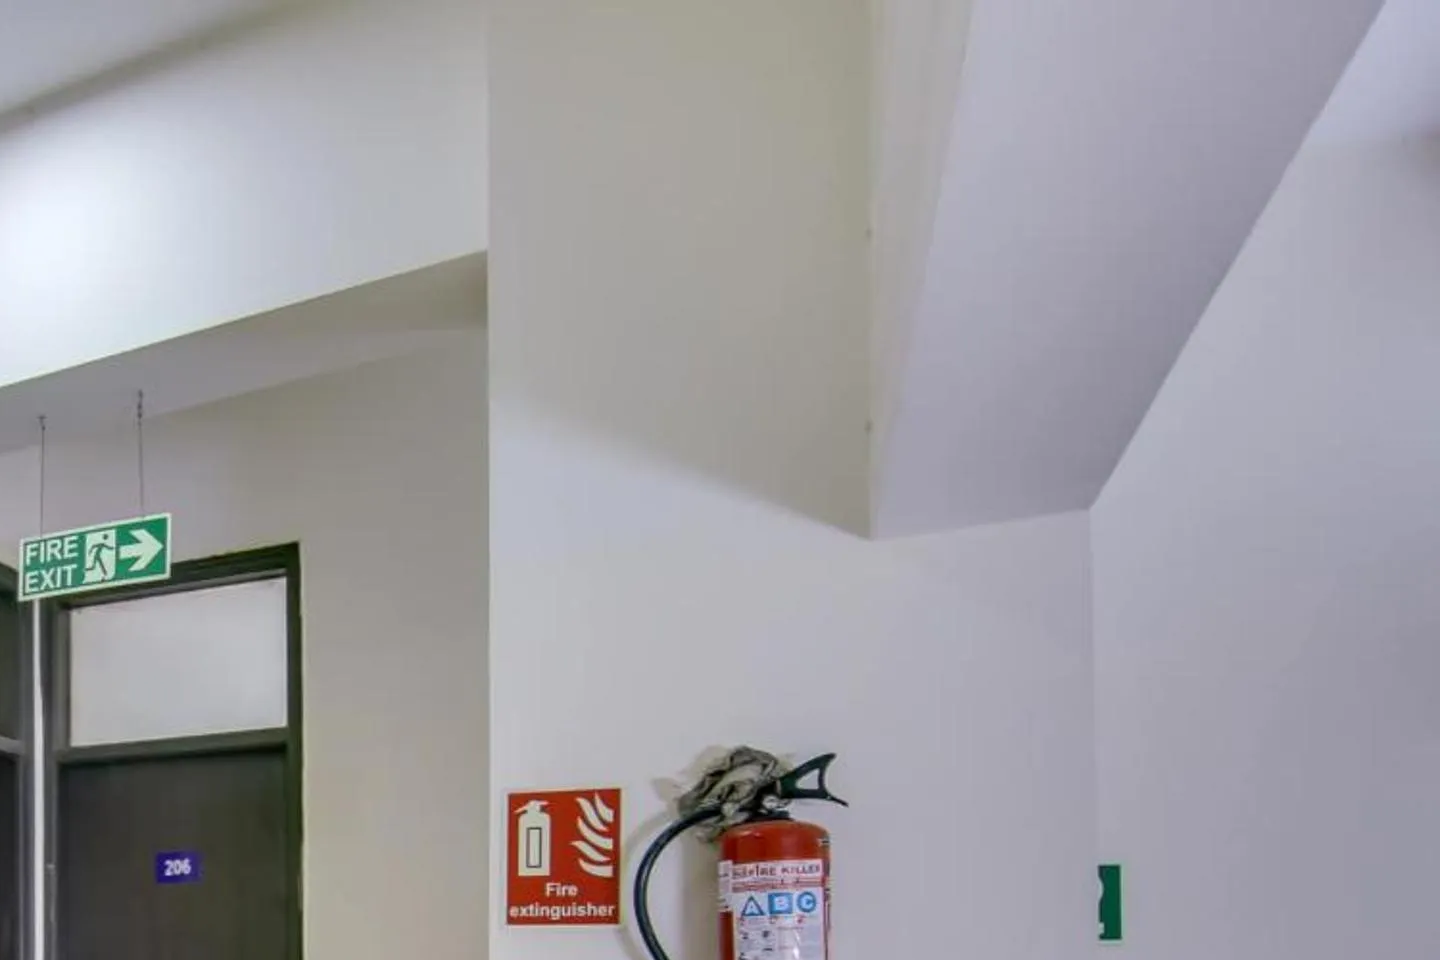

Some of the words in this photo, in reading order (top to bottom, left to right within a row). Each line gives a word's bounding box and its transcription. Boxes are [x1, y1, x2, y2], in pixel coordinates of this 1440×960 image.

[25, 535, 79, 566] FIRE
[25, 563, 78, 594] EXIT
[164, 858, 192, 876] 206
[545, 882, 579, 897] Fire
[509, 901, 615, 920] extinguisher
